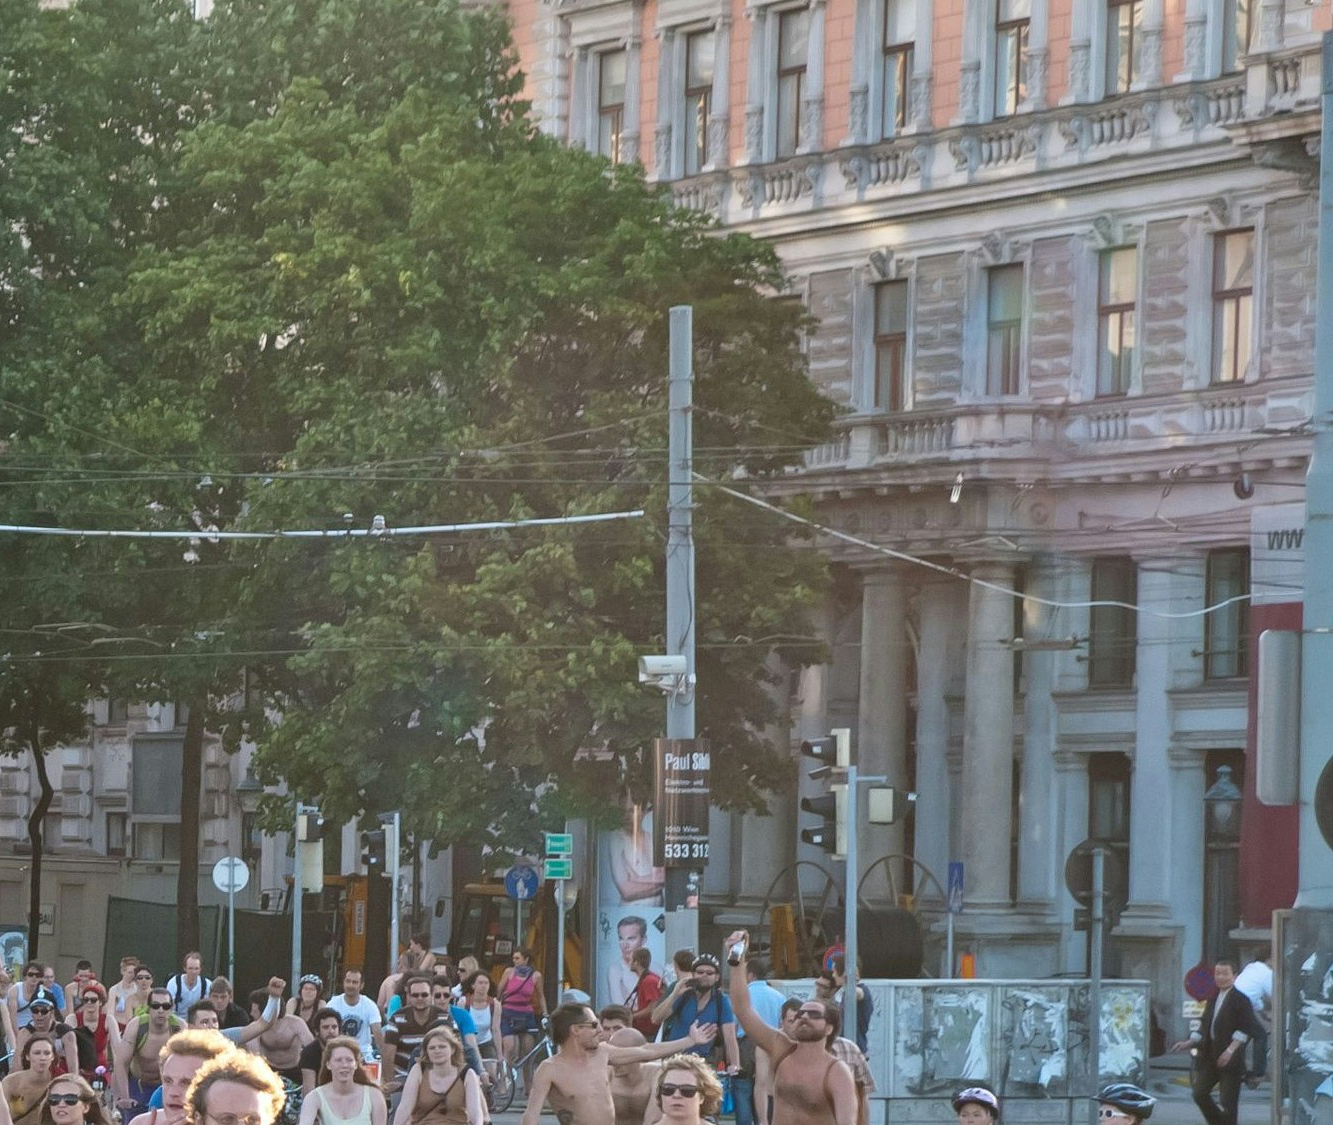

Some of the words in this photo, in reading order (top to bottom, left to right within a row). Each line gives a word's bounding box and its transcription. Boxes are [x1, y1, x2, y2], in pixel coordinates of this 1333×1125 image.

[1267, 528, 1305, 550] ww
[665, 753, 690, 770] Paul
[665, 843, 689, 858] 533
